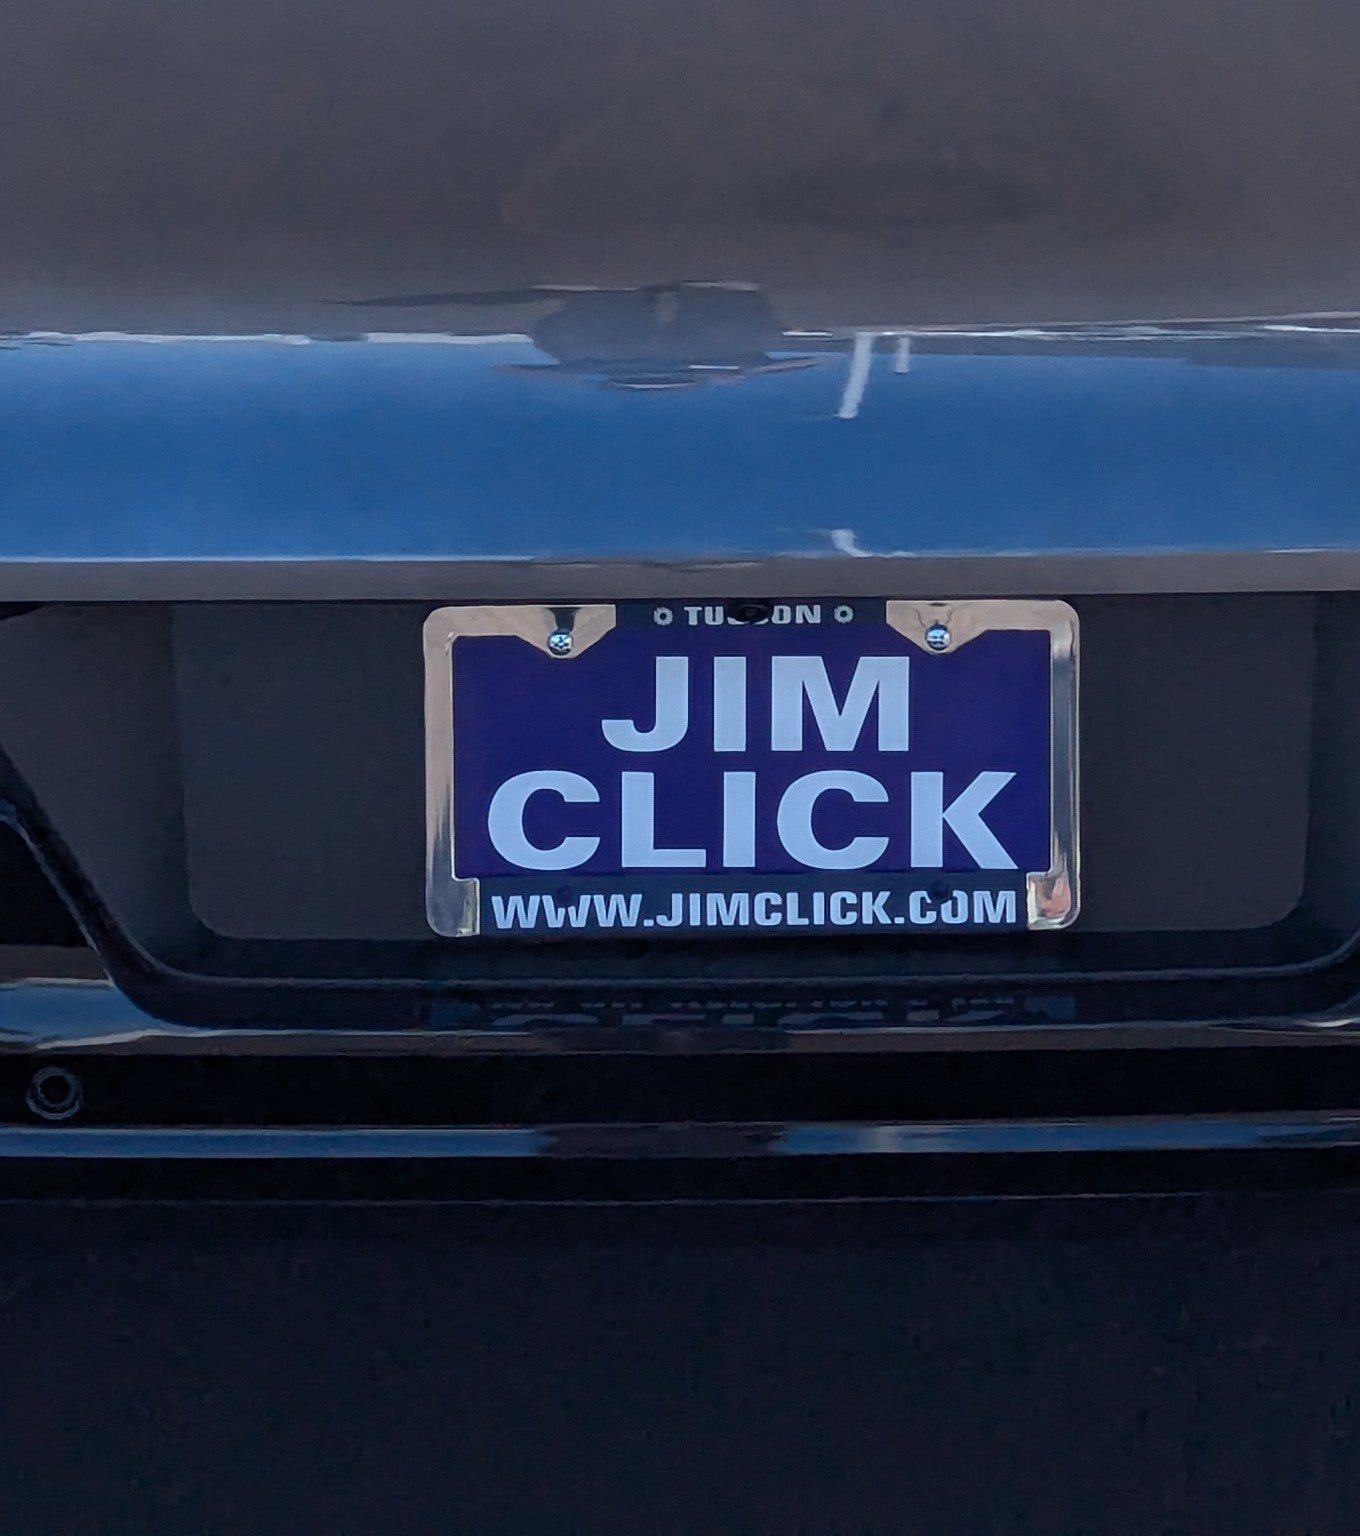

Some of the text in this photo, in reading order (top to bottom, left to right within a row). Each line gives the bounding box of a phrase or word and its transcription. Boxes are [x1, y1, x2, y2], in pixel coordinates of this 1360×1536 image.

[683, 604, 822, 627] TUON
[600, 655, 911, 753] JIM
[487, 769, 1019, 871] CLICK
[491, 889, 1017, 930] WWW.JIMCLICK.COM
